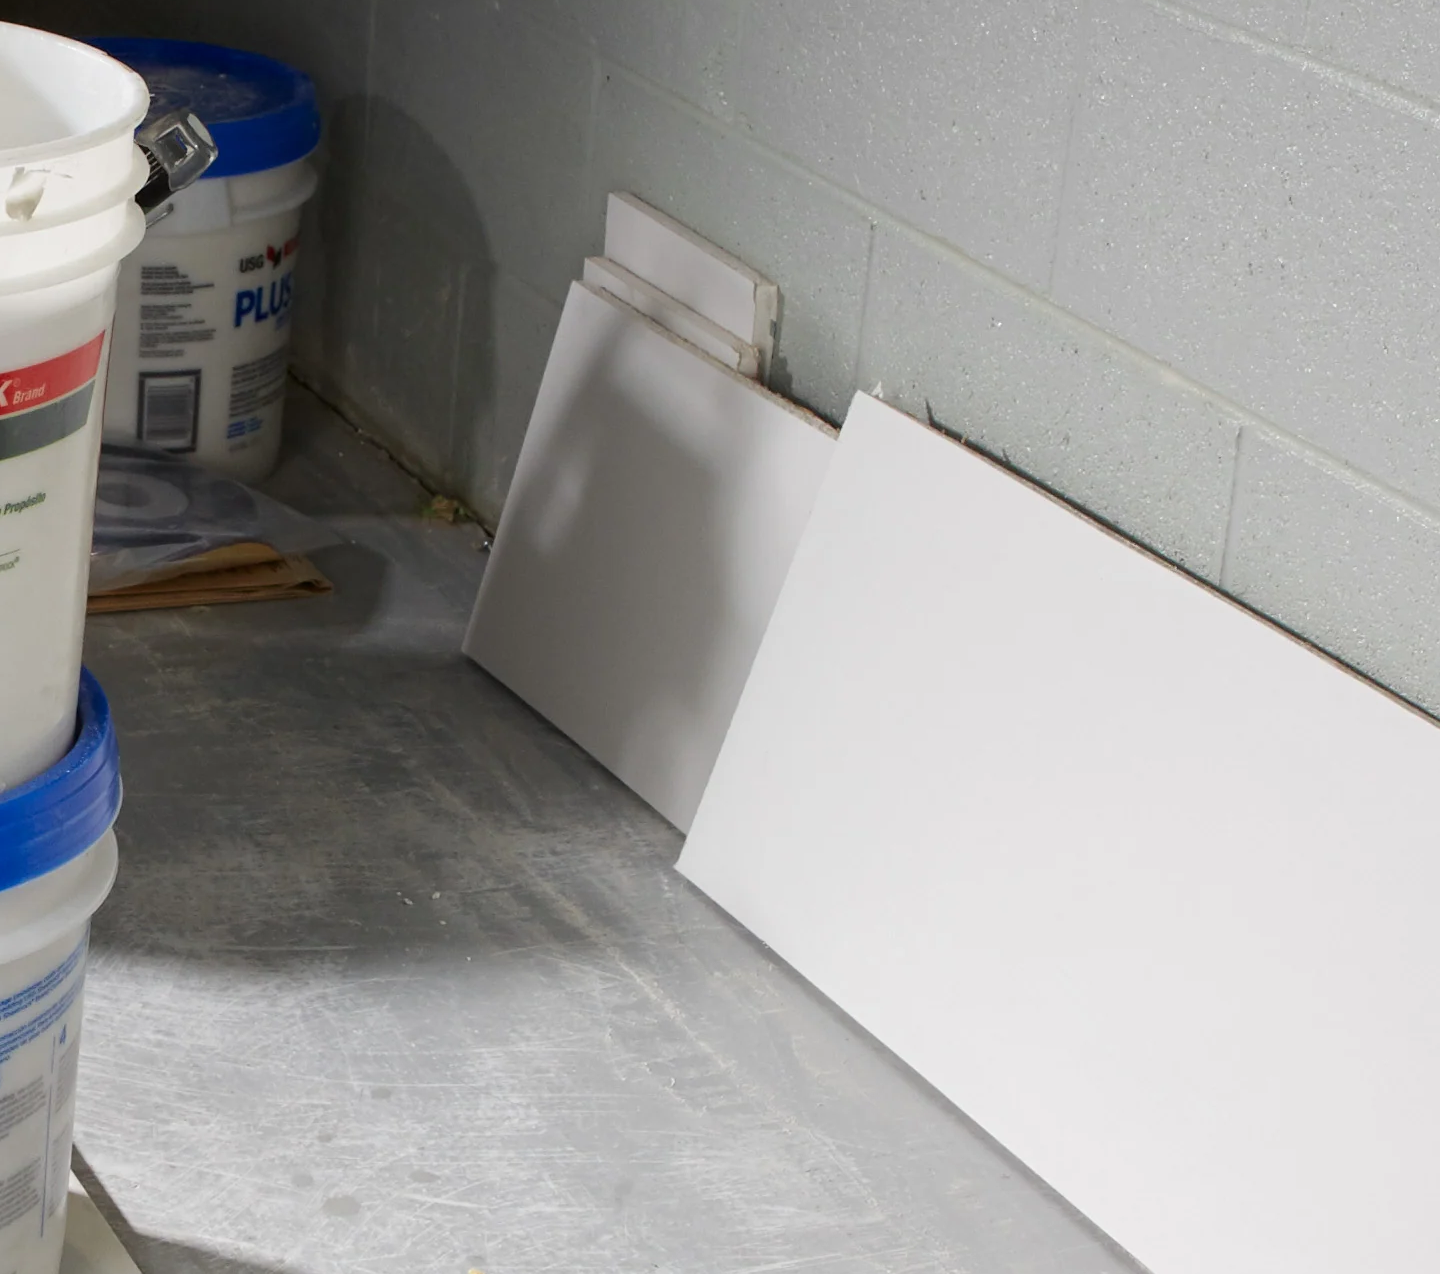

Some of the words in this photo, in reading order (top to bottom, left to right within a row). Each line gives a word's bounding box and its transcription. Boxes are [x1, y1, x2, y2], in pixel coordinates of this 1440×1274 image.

[239, 254, 265, 274] USG
[12, 384, 46, 406] Brand
[3, 491, 47, 516] Propósito
